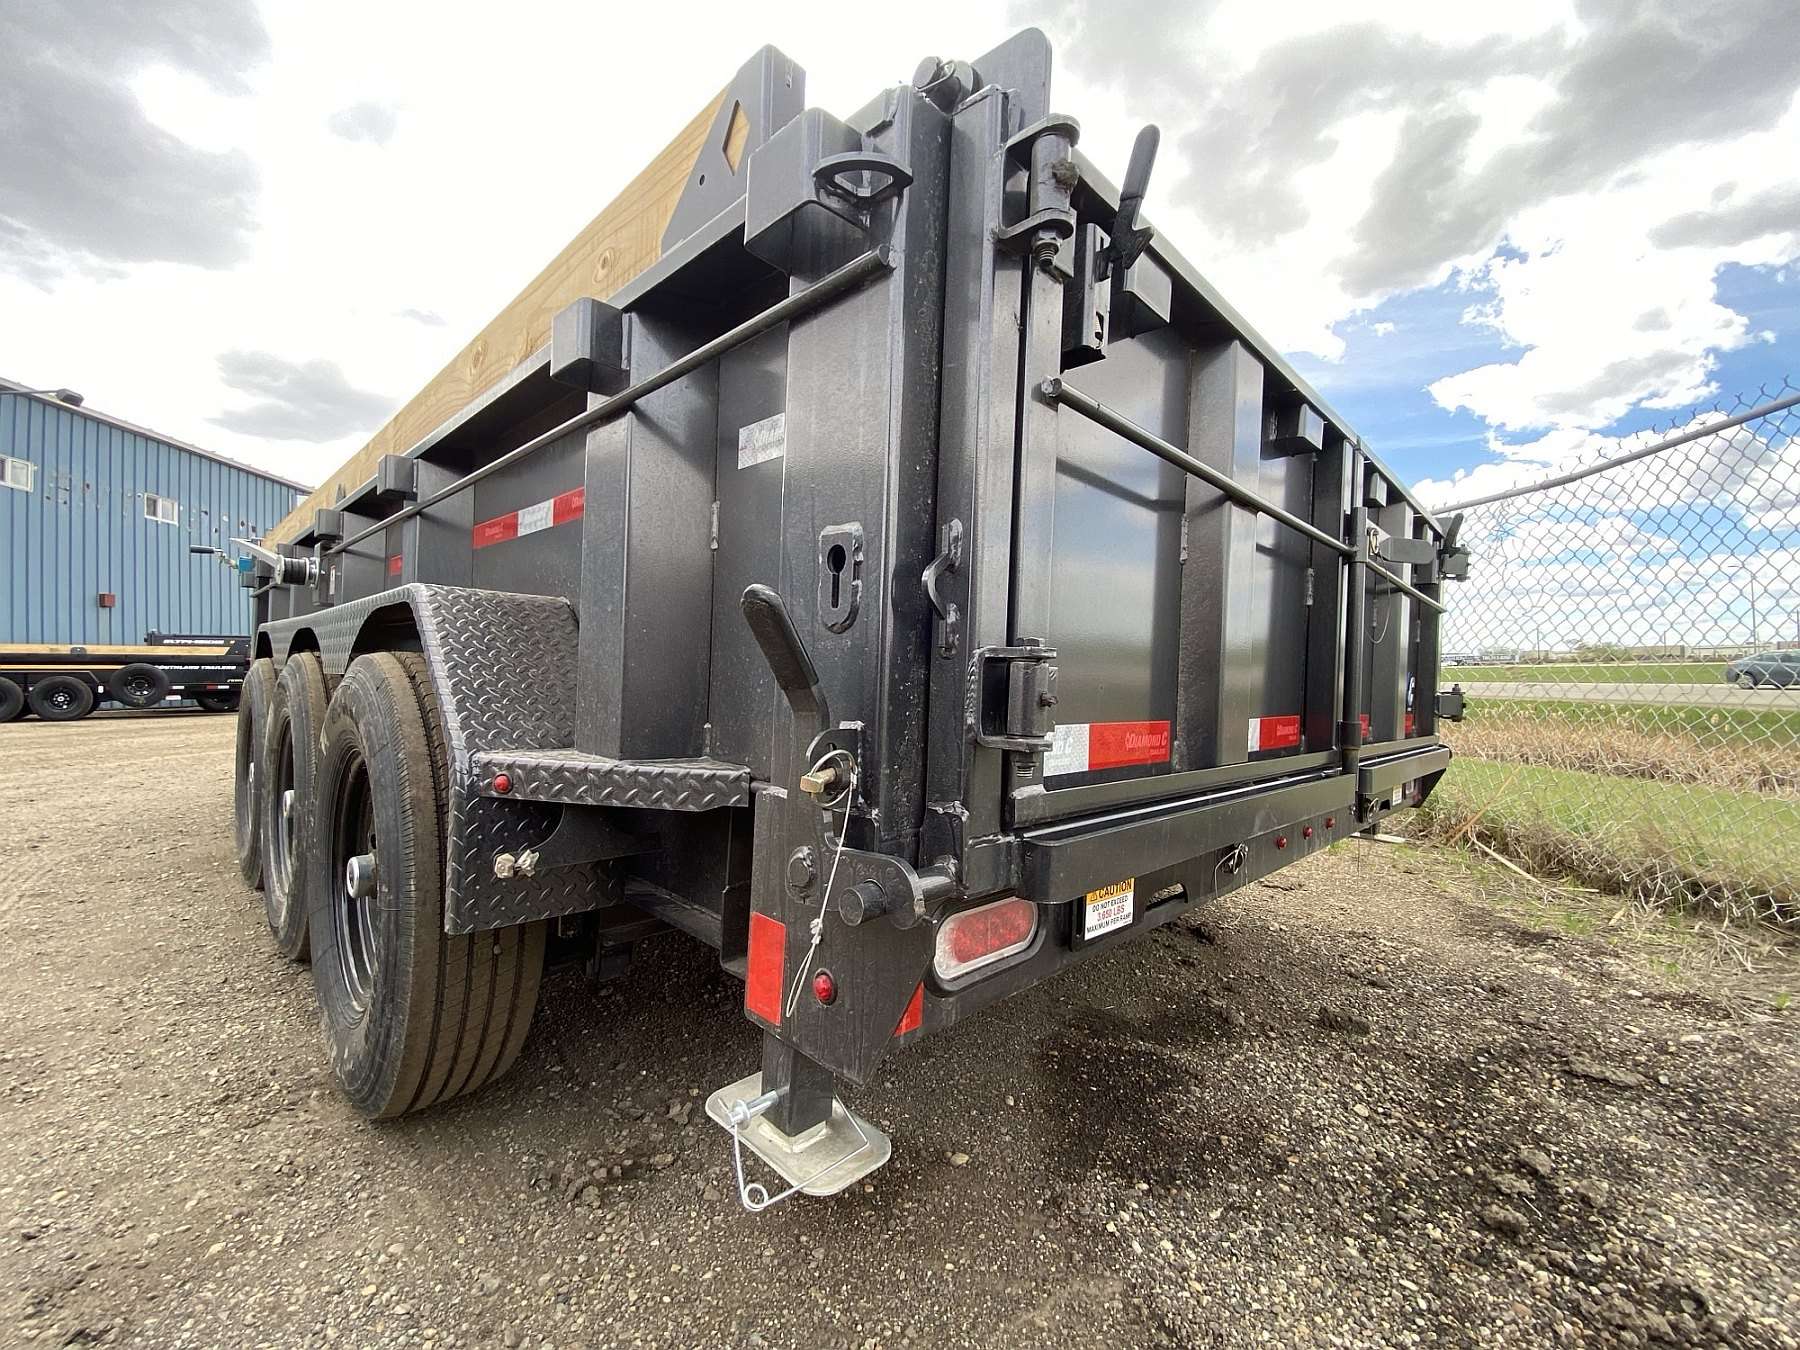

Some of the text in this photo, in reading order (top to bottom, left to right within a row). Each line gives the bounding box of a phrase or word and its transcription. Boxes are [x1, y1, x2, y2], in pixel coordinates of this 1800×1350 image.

[1161, 731, 1168, 746] C
[1099, 880, 1132, 899] CAUTION
[1092, 895, 1129, 912] DO NOT EXCEED
[1113, 905, 1125, 916] LBS
[1086, 920, 1110, 933] MAXIMUM
